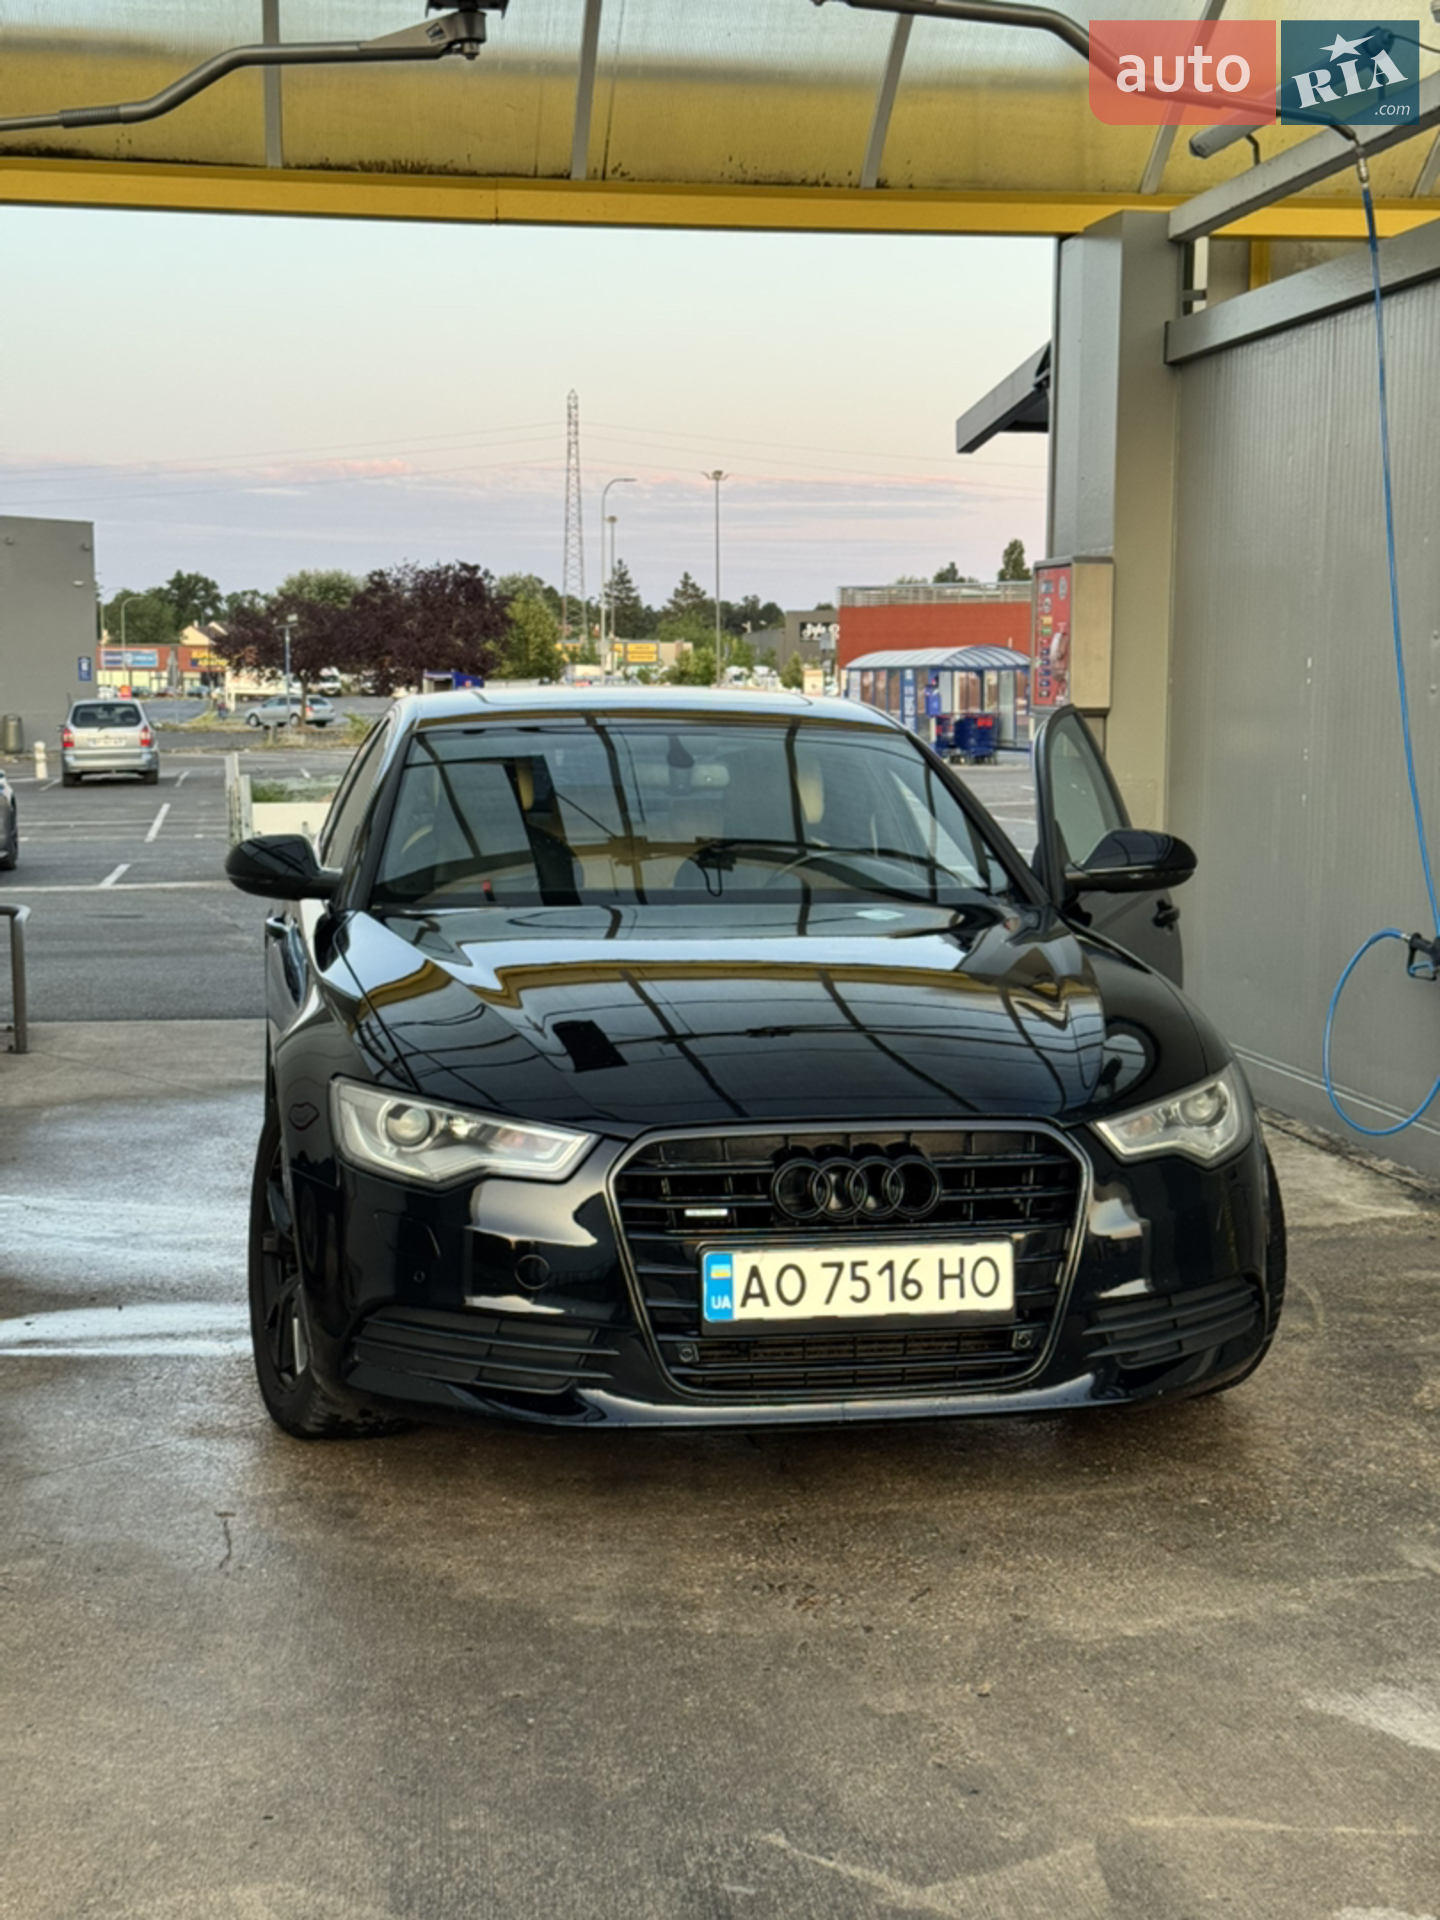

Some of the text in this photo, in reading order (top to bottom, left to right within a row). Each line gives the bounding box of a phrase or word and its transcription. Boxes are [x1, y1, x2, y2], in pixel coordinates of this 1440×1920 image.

[740, 1256, 1000, 1307] AO 7516 HO
[711, 1295, 731, 1309] UA
